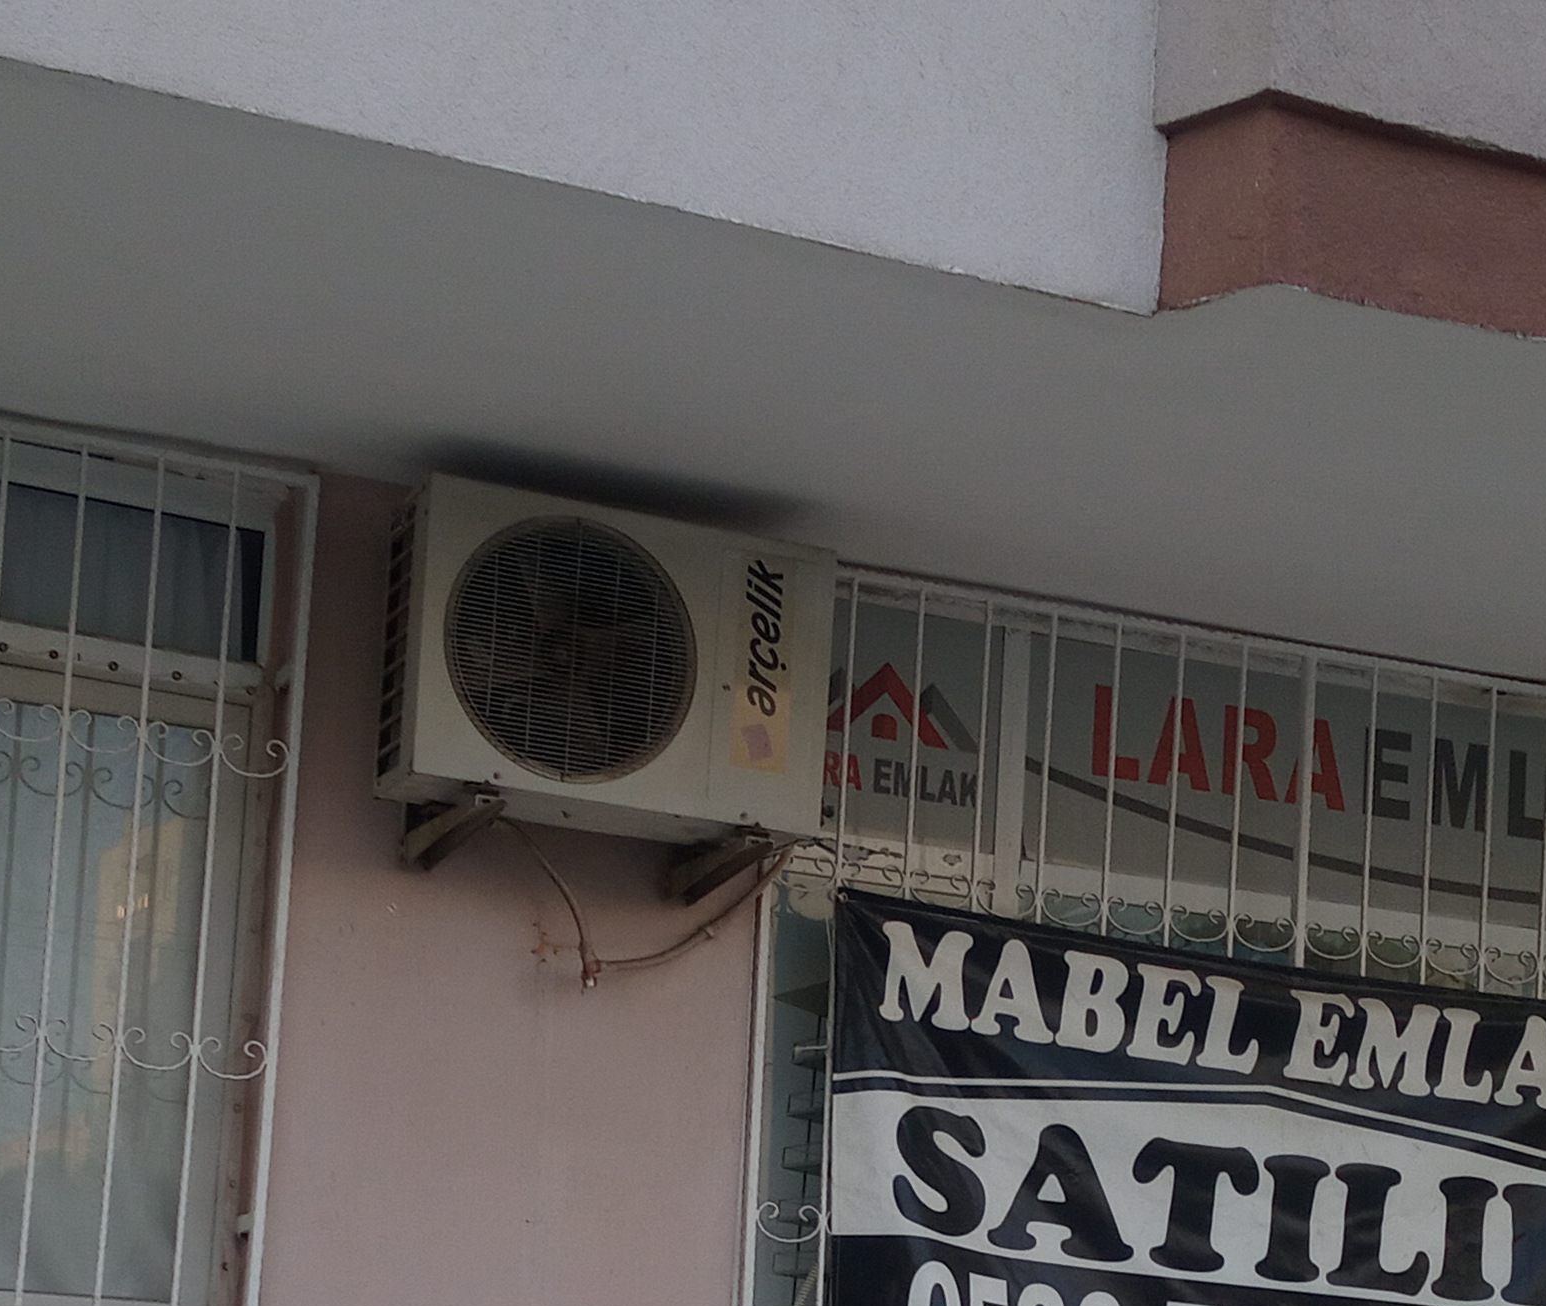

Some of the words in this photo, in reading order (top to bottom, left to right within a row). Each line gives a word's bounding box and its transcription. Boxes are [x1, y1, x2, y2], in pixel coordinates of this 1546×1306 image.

[746, 559, 787, 717] arçelik
[823, 750, 862, 791] RA
[1091, 684, 1345, 811] LARA
[879, 921, 1259, 1075] MABEL
